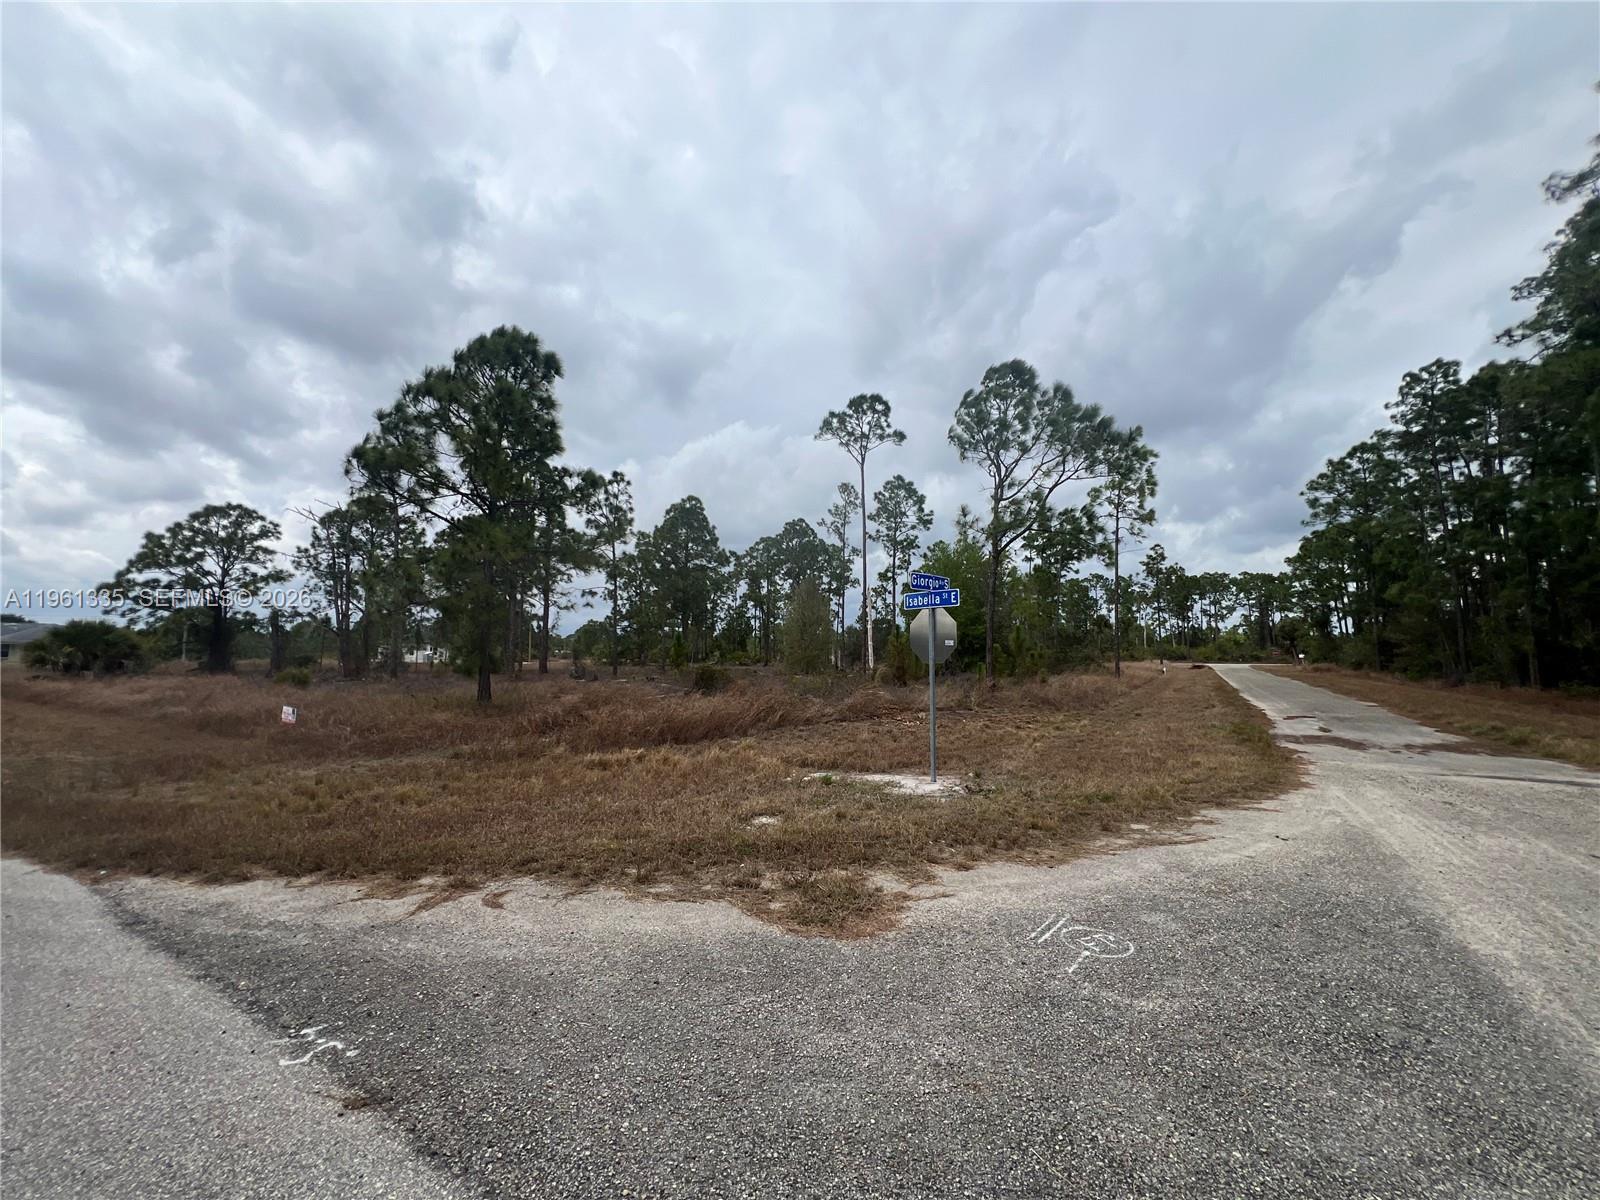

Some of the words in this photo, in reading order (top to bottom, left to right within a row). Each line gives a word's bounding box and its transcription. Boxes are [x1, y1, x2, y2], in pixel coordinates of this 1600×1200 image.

[911, 574, 939, 589] Giorgio
[944, 580, 948, 589] S
[906, 595, 940, 606] Isabella
[951, 592, 957, 602] E
